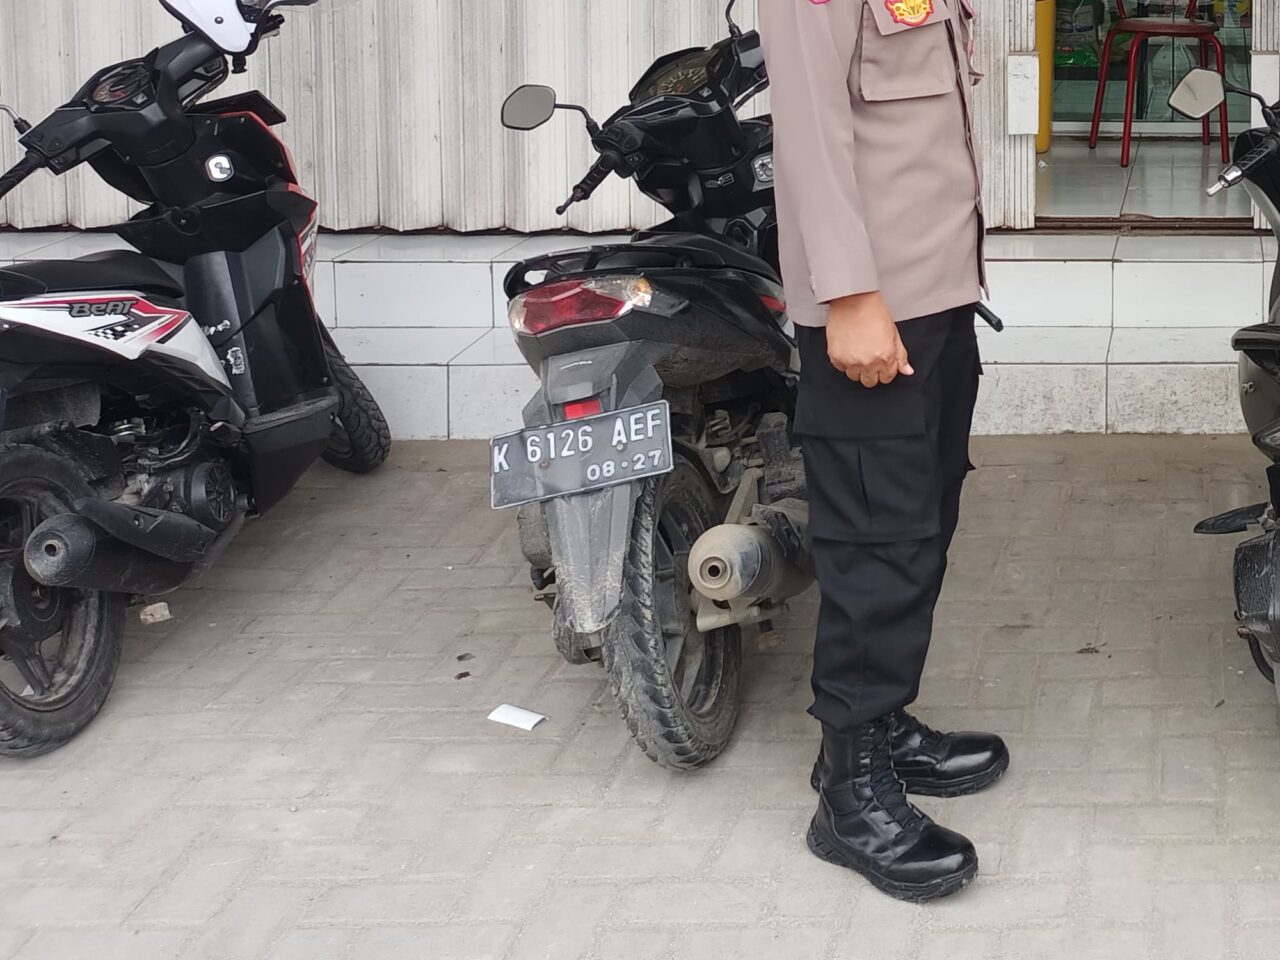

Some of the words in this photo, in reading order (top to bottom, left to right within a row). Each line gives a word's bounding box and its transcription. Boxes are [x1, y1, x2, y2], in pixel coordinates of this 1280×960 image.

[493, 443, 510, 473] K
[526, 426, 594, 463] 6126
[611, 408, 662, 447] AEF
